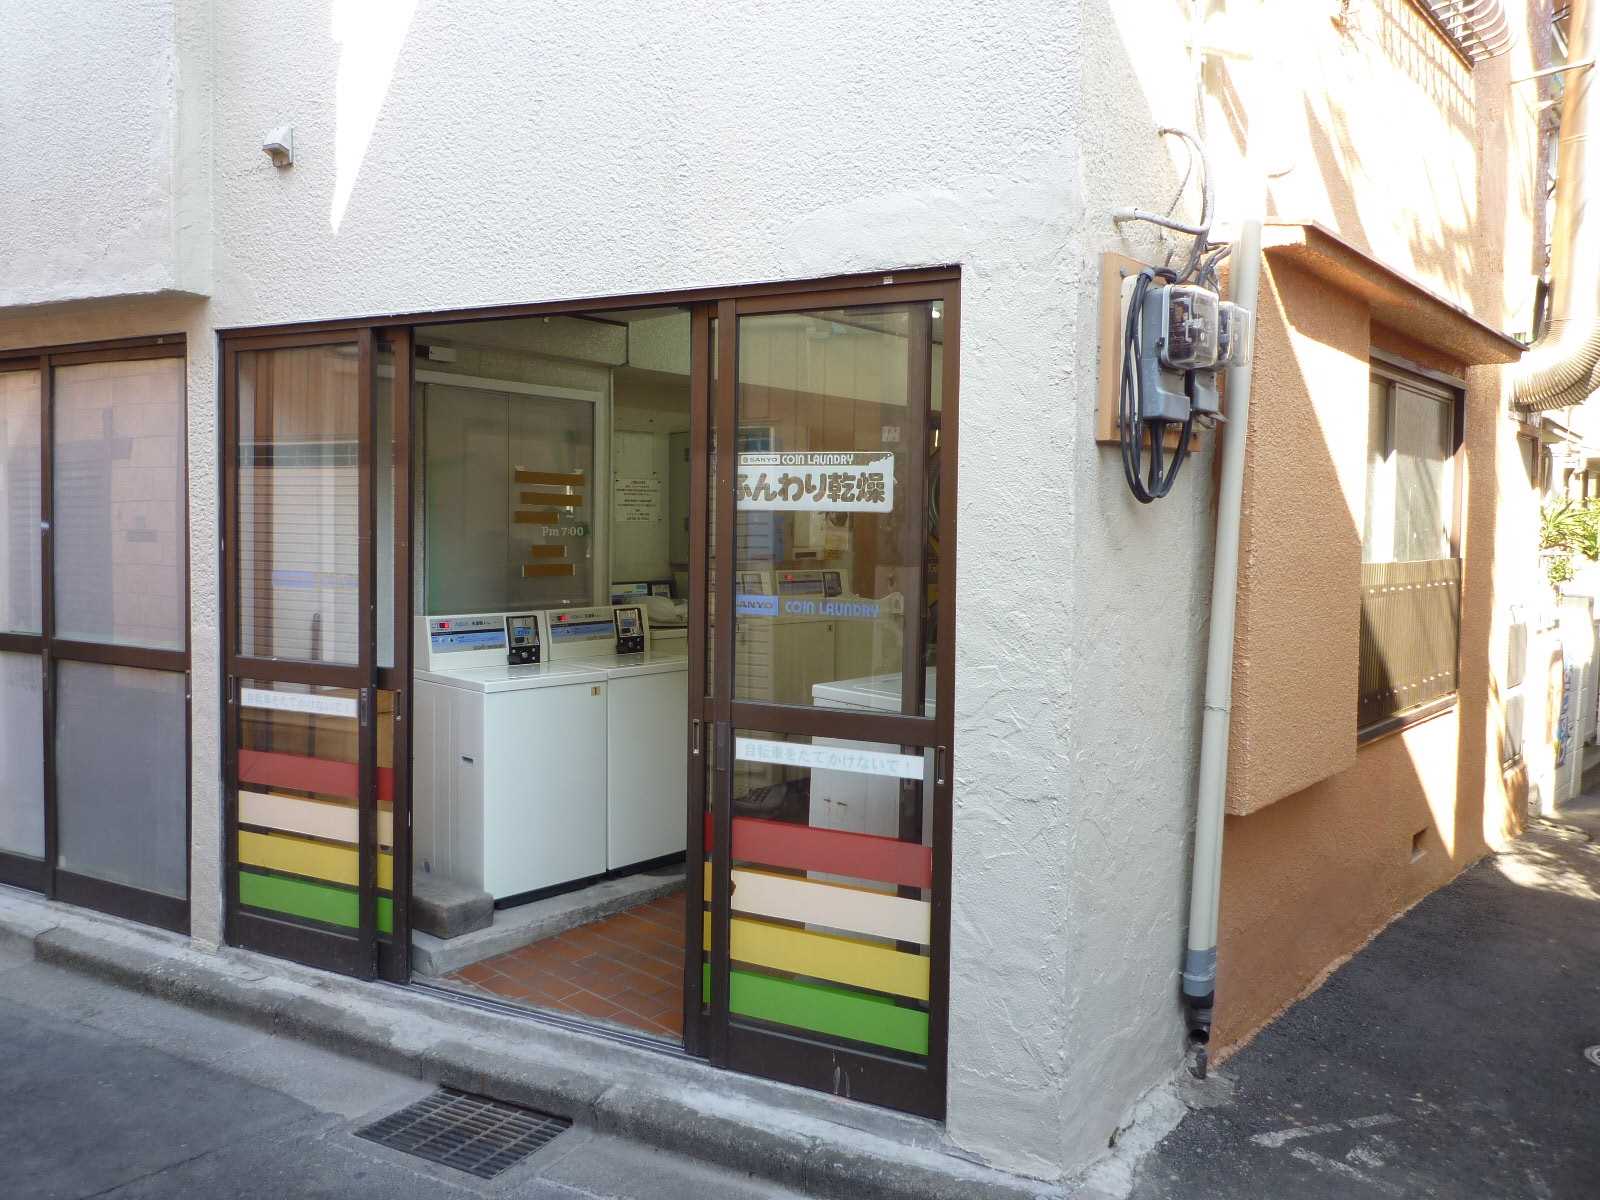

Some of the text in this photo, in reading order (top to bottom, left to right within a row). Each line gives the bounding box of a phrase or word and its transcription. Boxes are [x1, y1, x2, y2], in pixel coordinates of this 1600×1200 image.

[782, 454, 805, 465] COIN
[808, 453, 855, 465] LAUNDRY
[737, 472, 886, 503] ふんわり乾燥
[560, 526, 584, 537] 7:00
[784, 601, 815, 615] COIN
[819, 601, 880, 618] LAUNDRY
